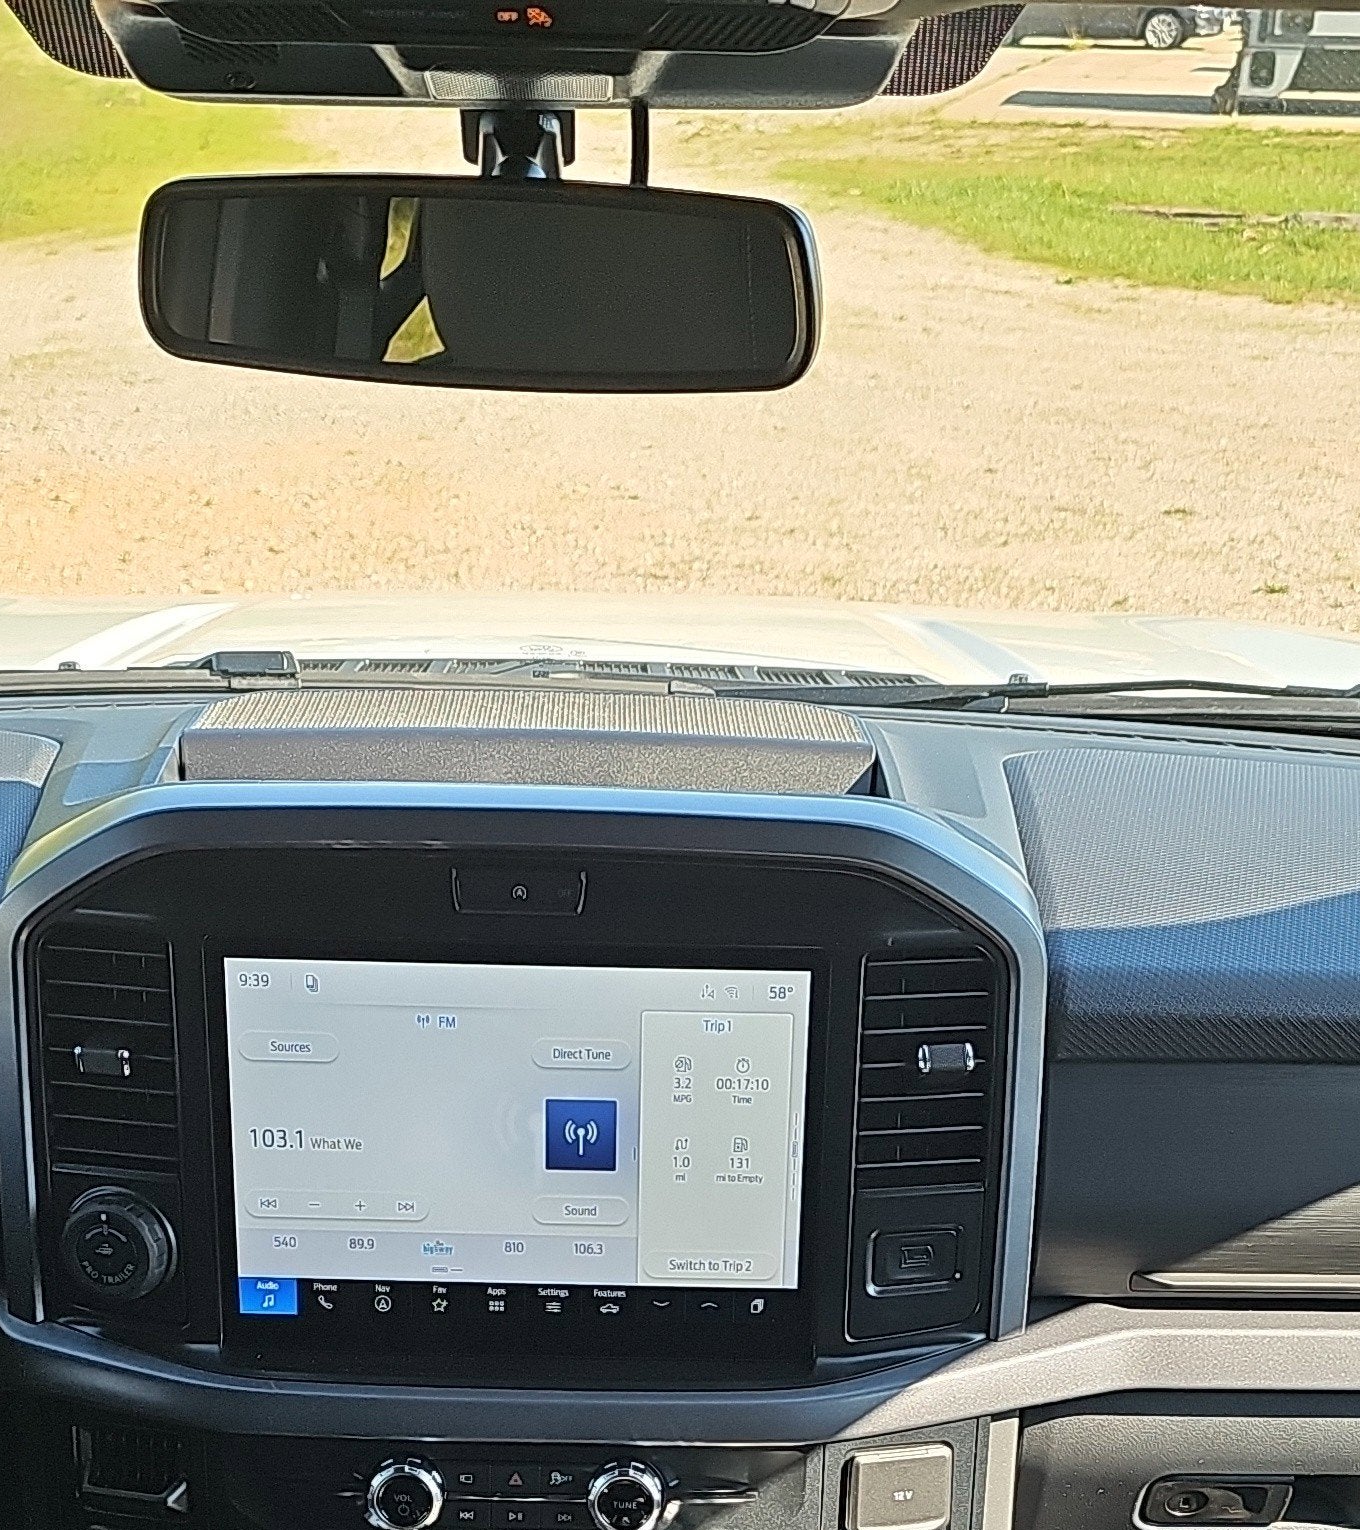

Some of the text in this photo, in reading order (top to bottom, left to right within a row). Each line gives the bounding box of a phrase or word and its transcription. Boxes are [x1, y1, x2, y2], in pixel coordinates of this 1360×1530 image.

[239, 974, 270, 987] 9:39
[438, 1016, 456, 1028] FM
[703, 1020, 724, 1033] Trip
[270, 1041, 311, 1053] Sources
[553, 1048, 611, 1061] Direct Tune
[673, 1078, 691, 1089] 3.2
[716, 1079, 770, 1091] 00:17:10
[673, 1095, 692, 1104] MPG
[732, 1095, 752, 1104] Time
[249, 1128, 363, 1151] 103.1 What We
[672, 1157, 691, 1168] 1.0
[729, 1157, 750, 1169] 131
[716, 1174, 726, 1182] mi
[737, 1175, 763, 1185] Empty
[565, 1205, 597, 1217] Sound
[274, 1236, 297, 1248] 540
[349, 1238, 375, 1250] 89.9
[504, 1242, 524, 1253] 810
[574, 1243, 603, 1255] 106.3
[669, 1259, 752, 1274] Switch to Trip 2
[82, 1261, 136, 1284] PRO TRAILER
[257, 1281, 280, 1291] Audio
[313, 1283, 338, 1292] Phone
[375, 1284, 391, 1293] Nav
[433, 1286, 448, 1294] Fav
[487, 1287, 507, 1297] Apps
[538, 1288, 569, 1298] Settings
[594, 1289, 627, 1298] Features
[394, 1495, 413, 1503] VOL
[613, 1501, 638, 1510] TUNE
